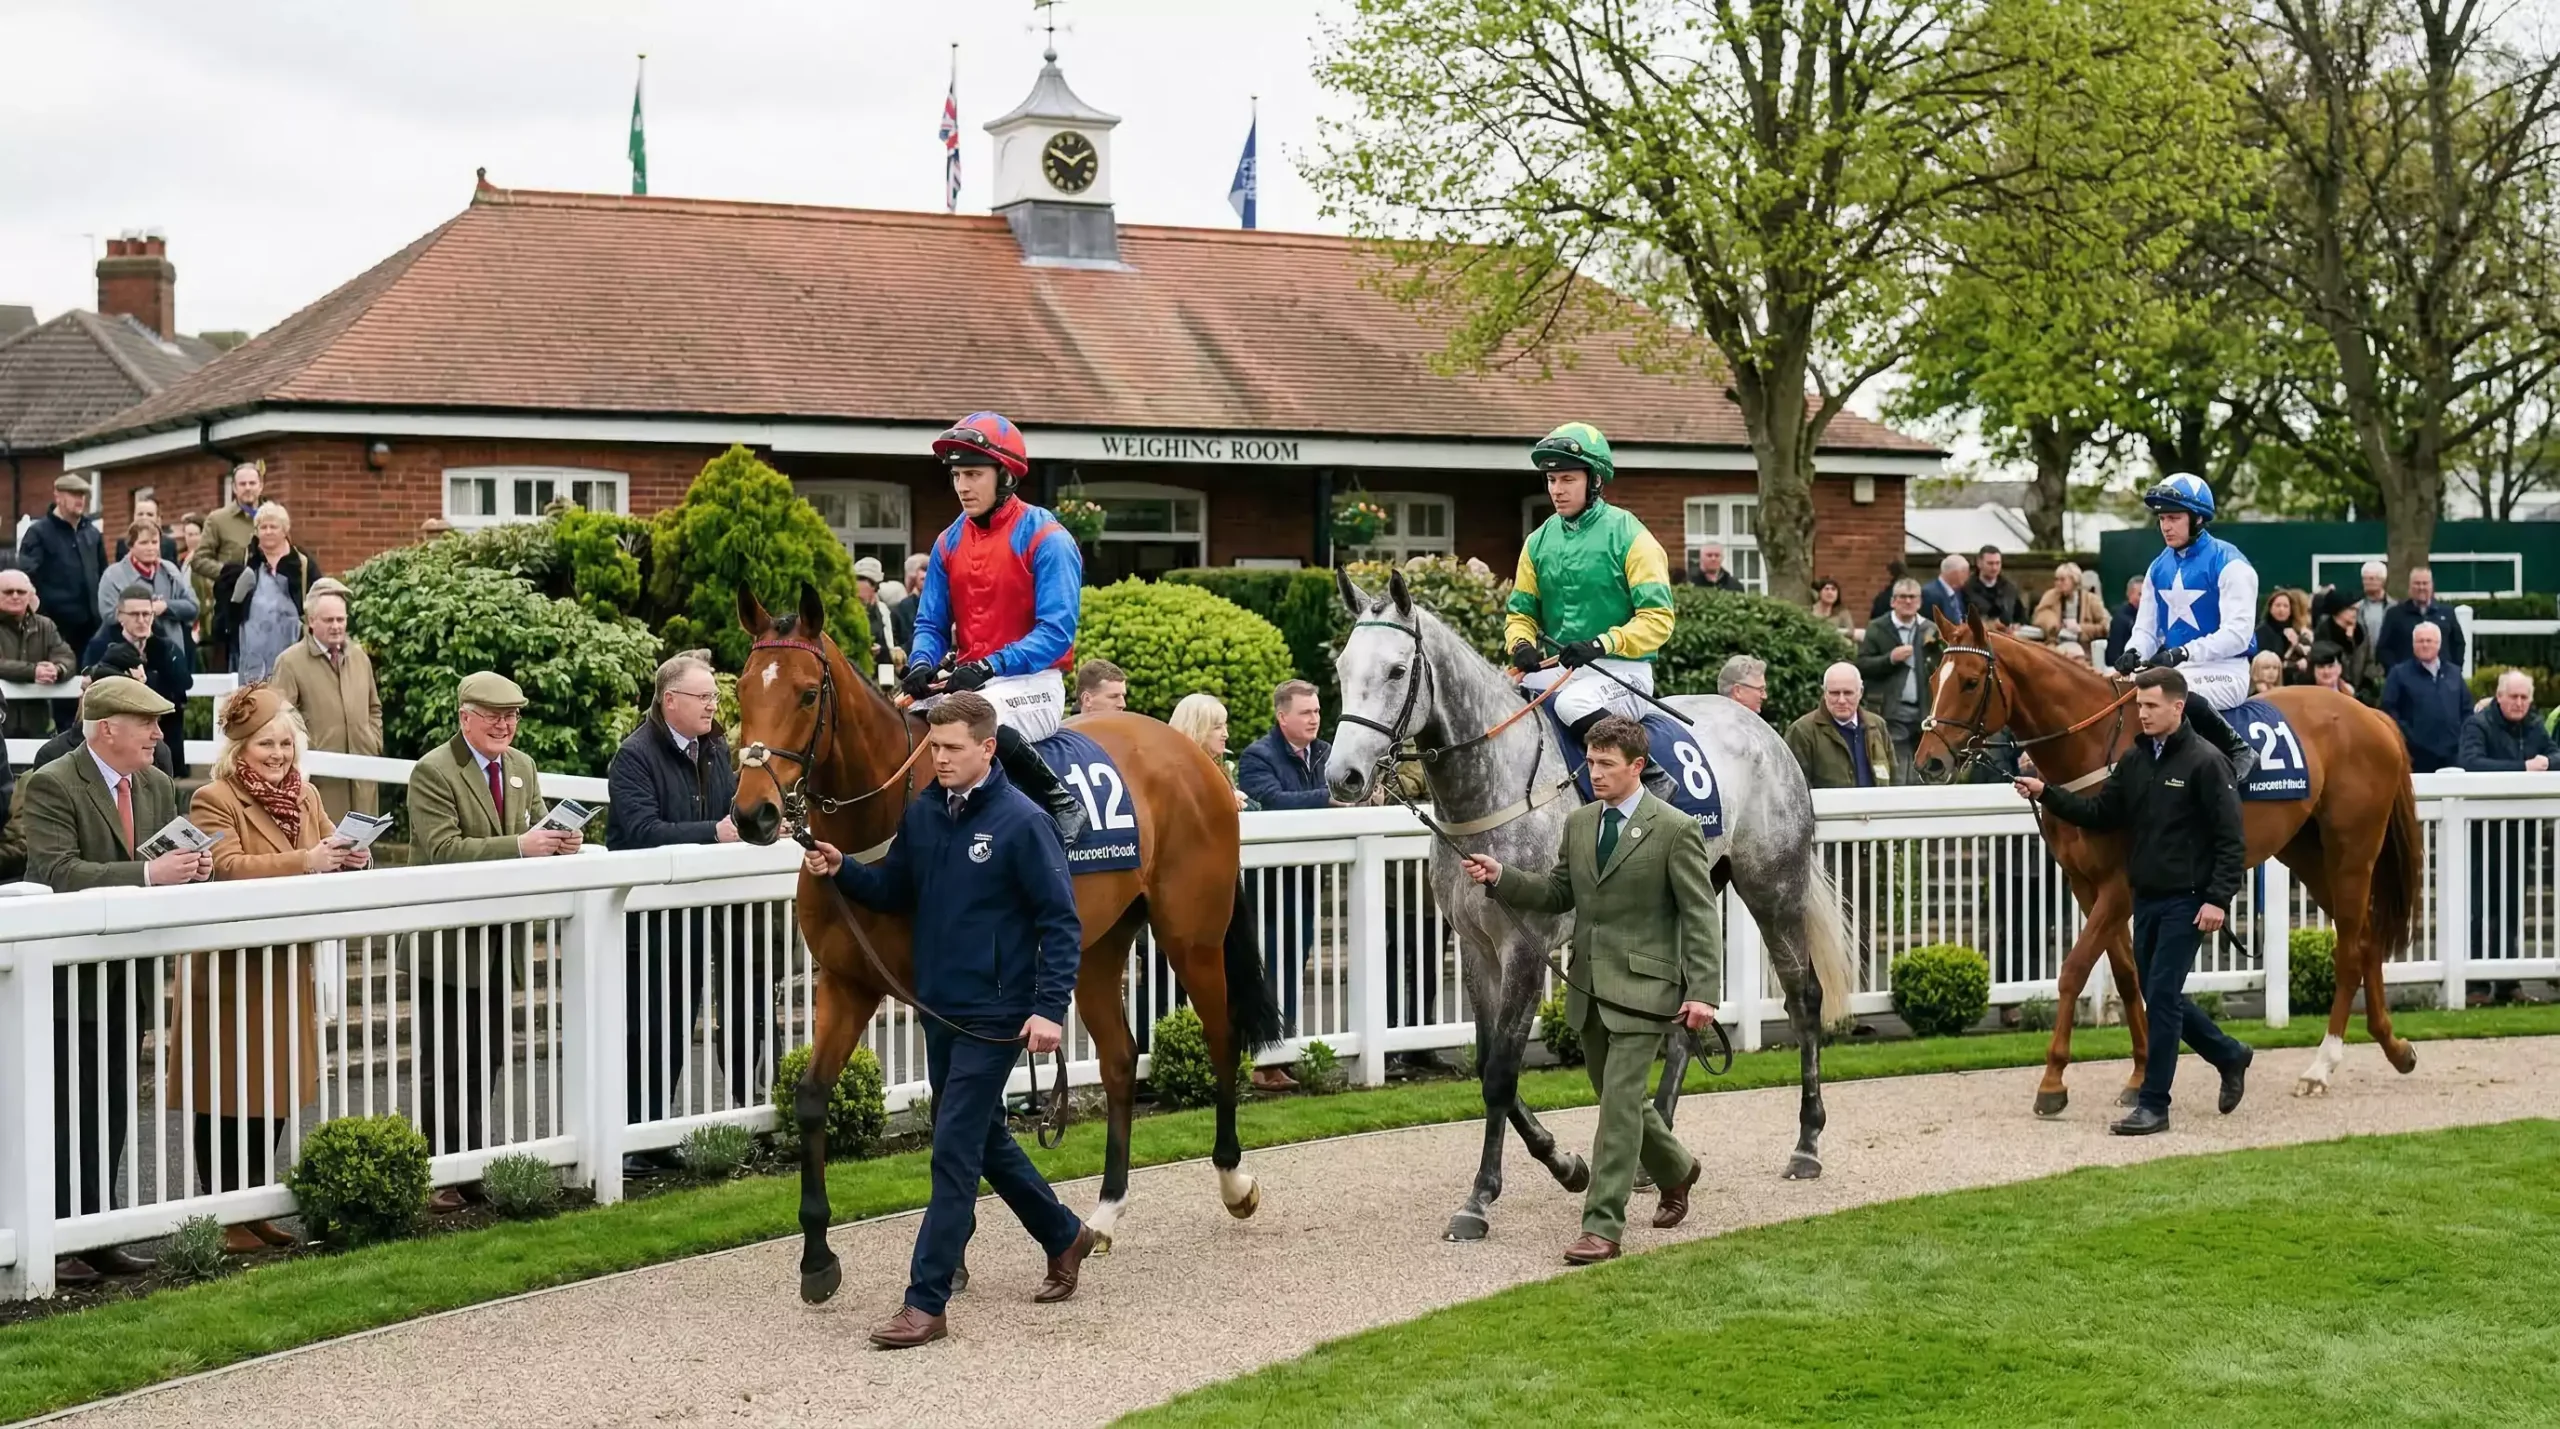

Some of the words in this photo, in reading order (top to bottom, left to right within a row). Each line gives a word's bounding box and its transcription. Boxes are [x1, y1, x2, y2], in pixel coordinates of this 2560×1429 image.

[1101, 436, 1222, 459] WEIGHING
[1230, 440, 1300, 461] ROOM
[1673, 741, 1713, 800] 8
[2248, 721, 2304, 771] 21
[1063, 762, 1135, 831] 12
